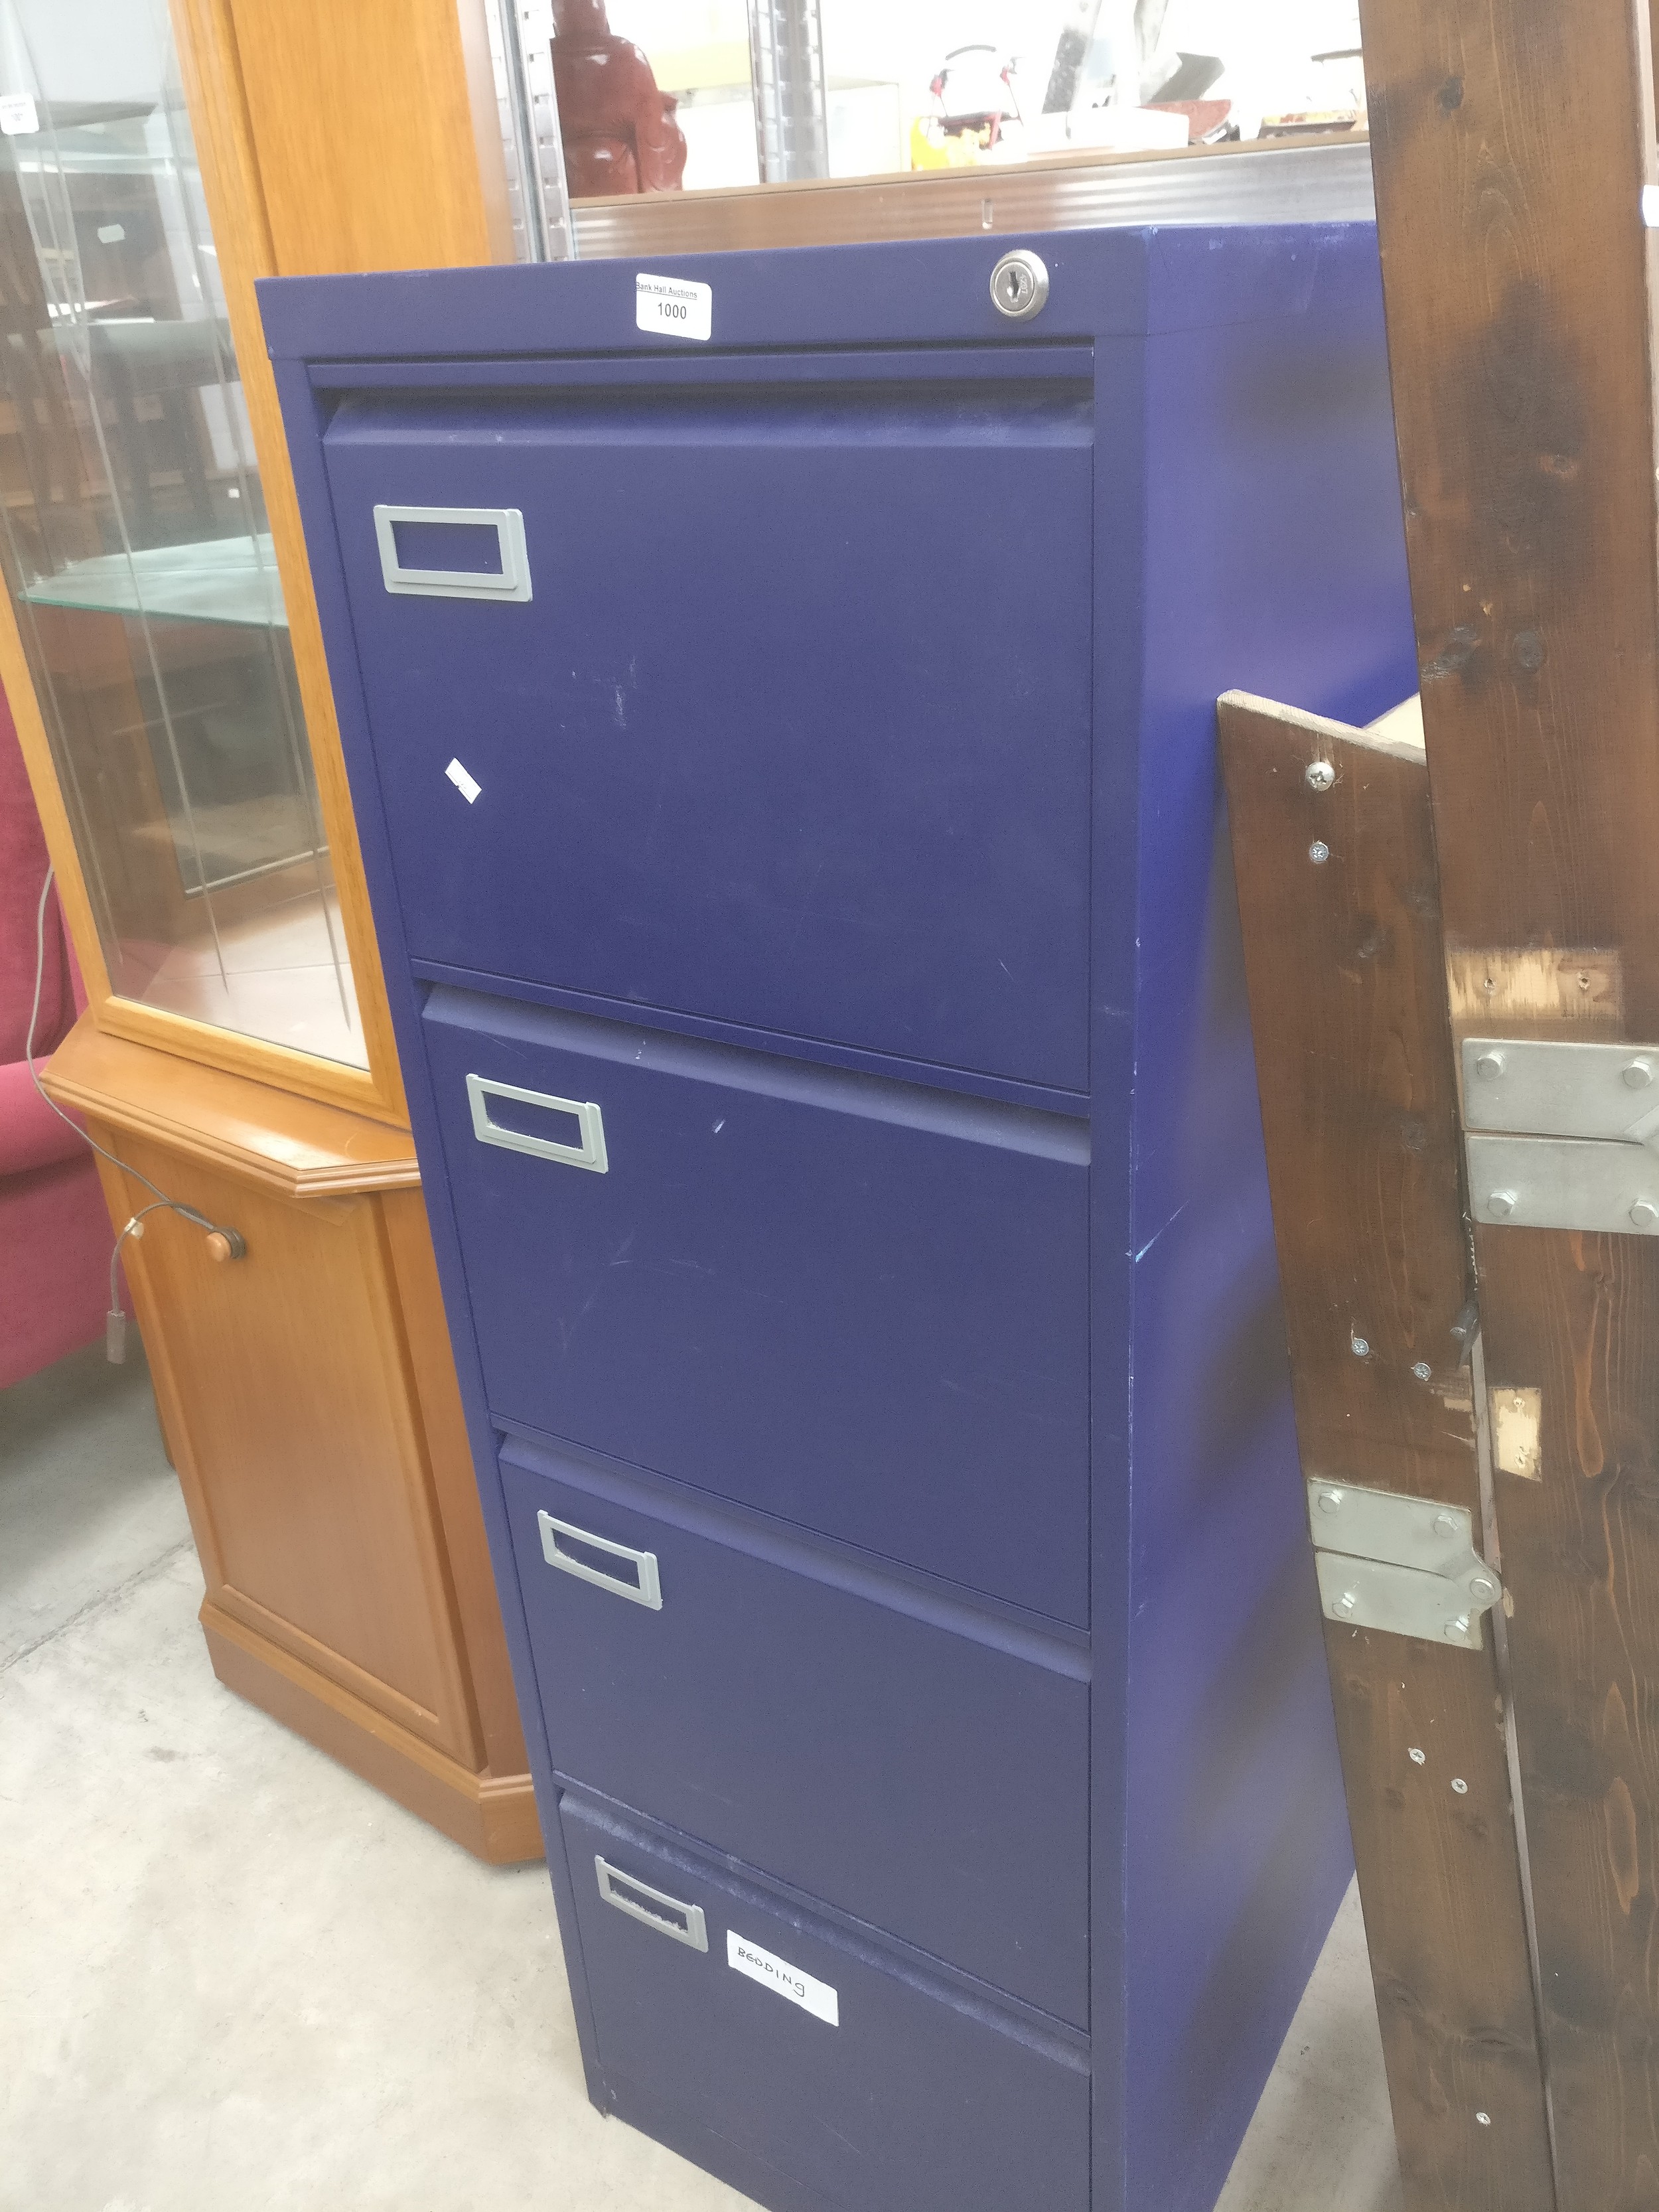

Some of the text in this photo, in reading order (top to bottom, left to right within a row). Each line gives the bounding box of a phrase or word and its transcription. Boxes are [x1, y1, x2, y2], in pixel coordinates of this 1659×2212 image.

[636, 282, 697, 298] Bank Hall Auctions
[658, 303, 686, 319] 1000
